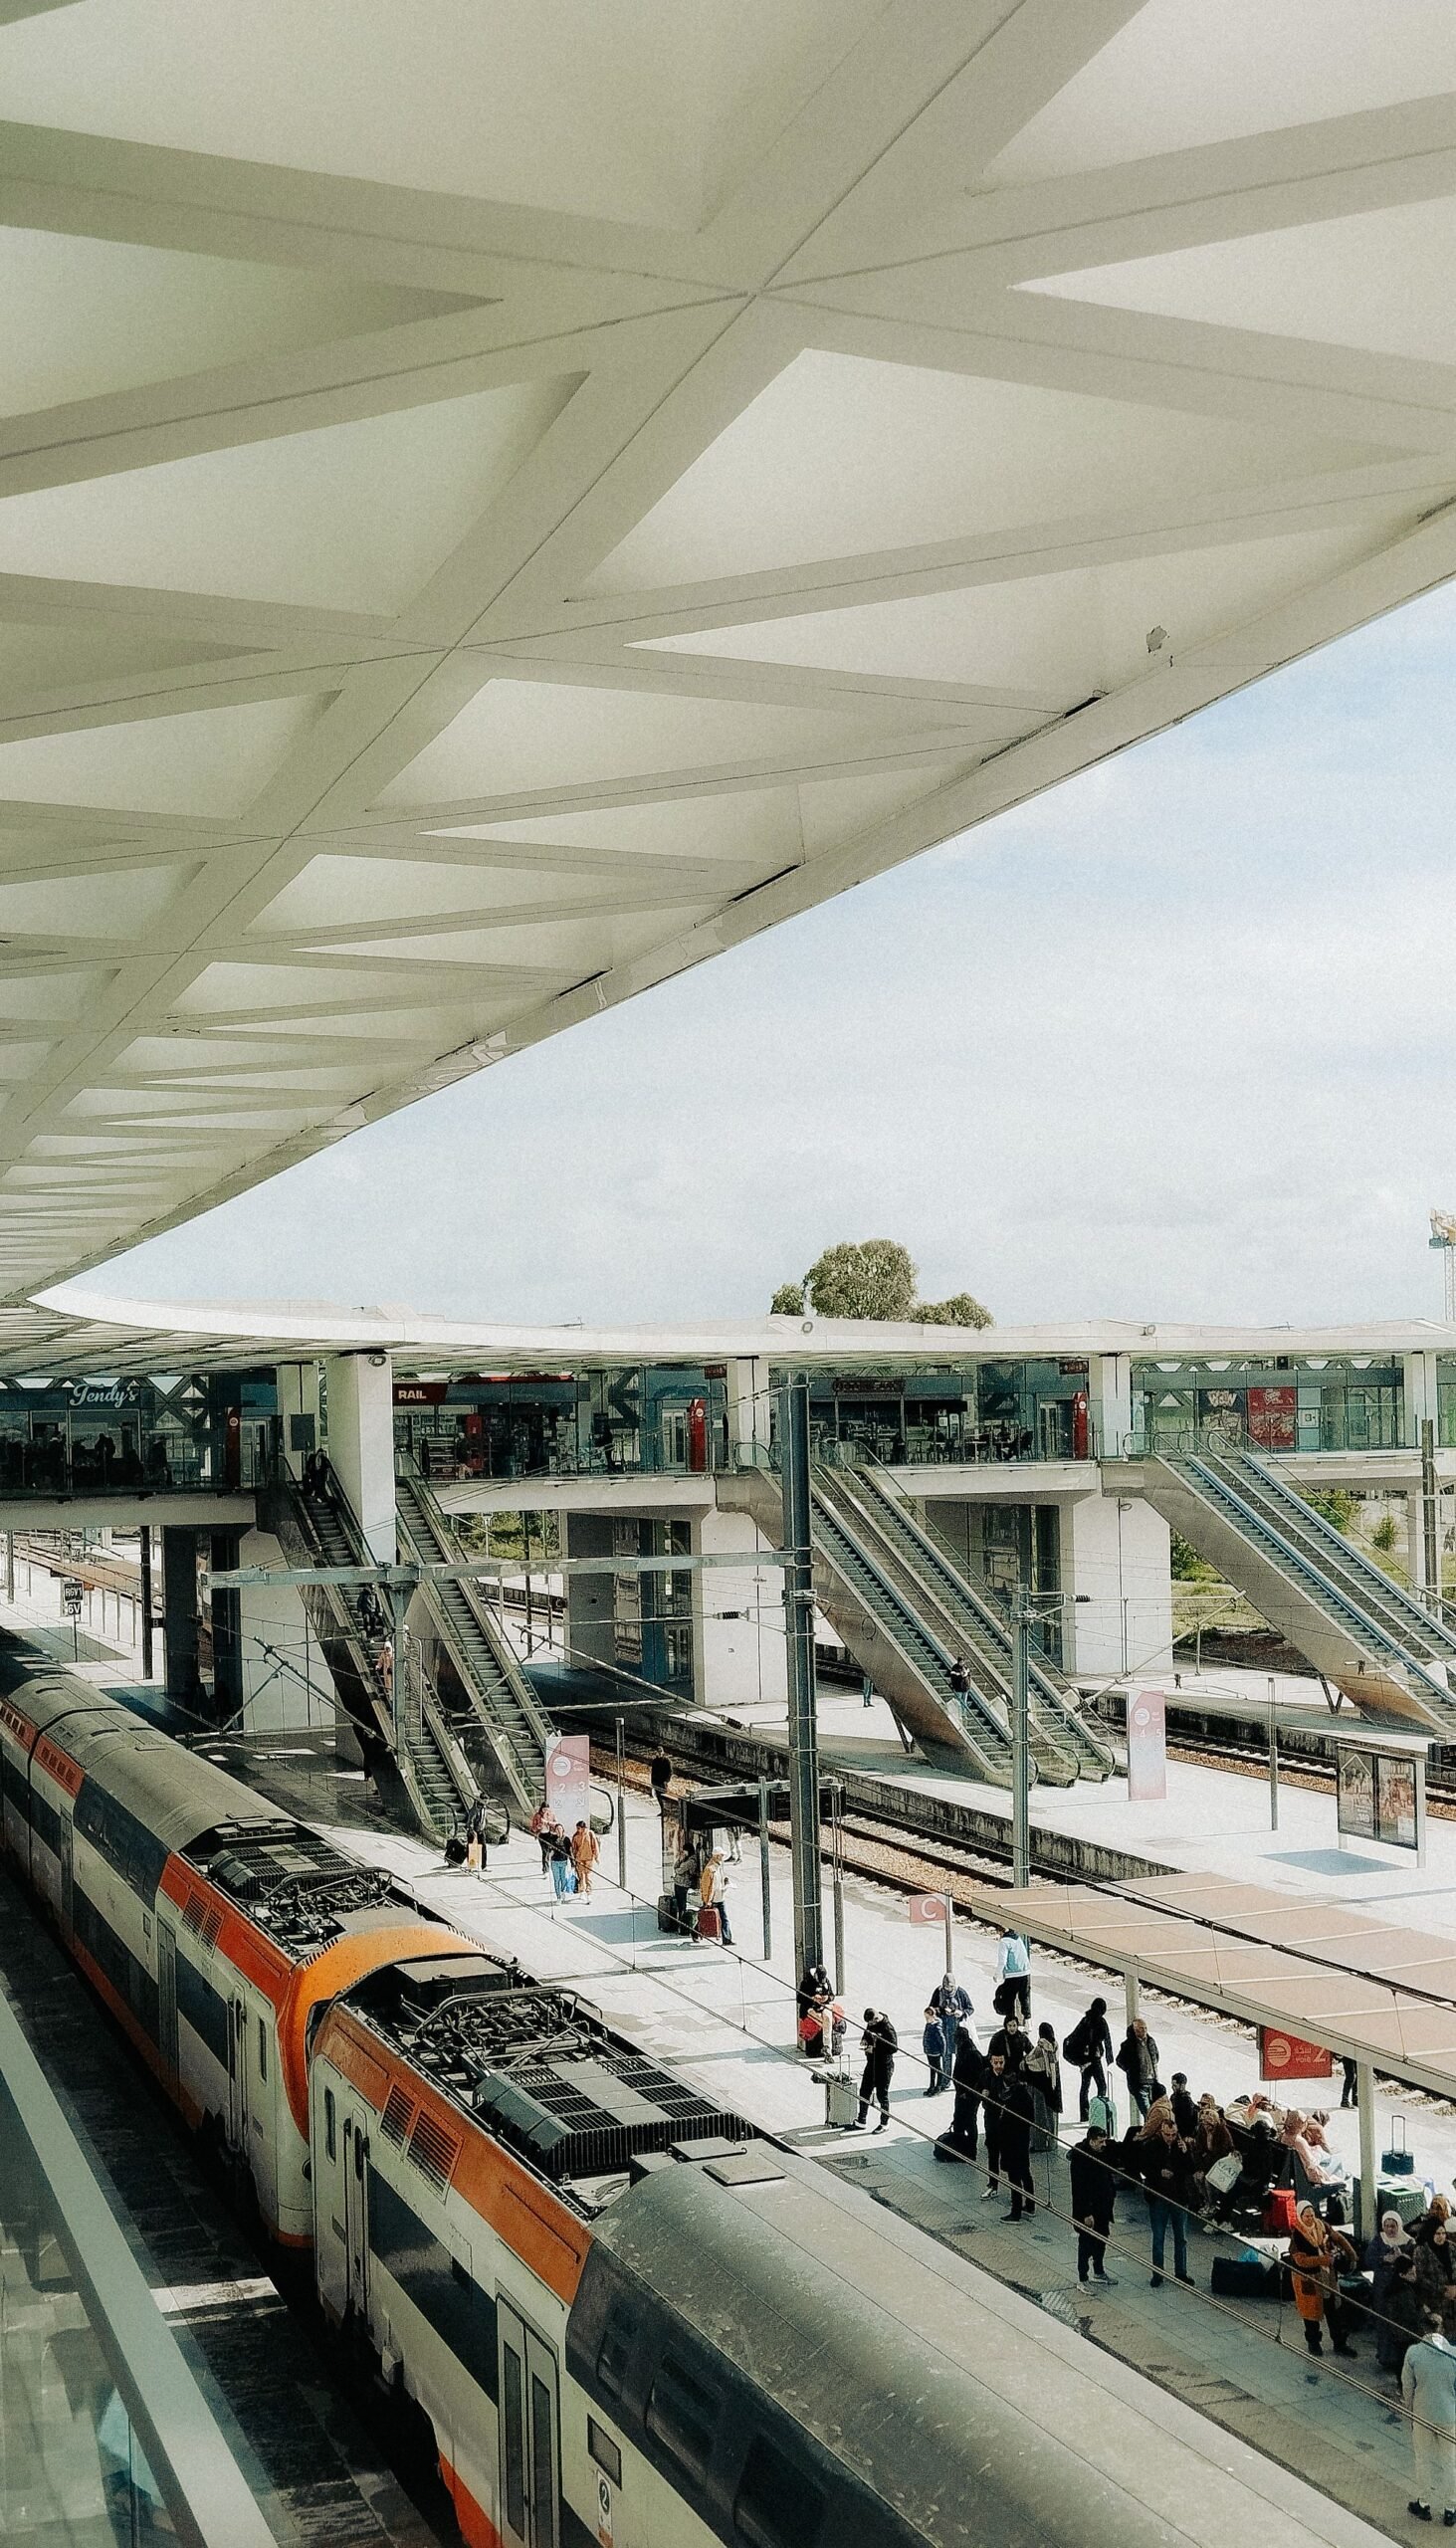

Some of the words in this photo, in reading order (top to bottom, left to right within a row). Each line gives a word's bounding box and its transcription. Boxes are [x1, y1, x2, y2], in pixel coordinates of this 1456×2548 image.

[398, 1389, 426, 1399] RAIL
[68, 1603, 80, 1613] 6V
[558, 1783, 566, 1794] 2
[578, 1781, 585, 1792] 3
[921, 1896, 937, 1919] C
